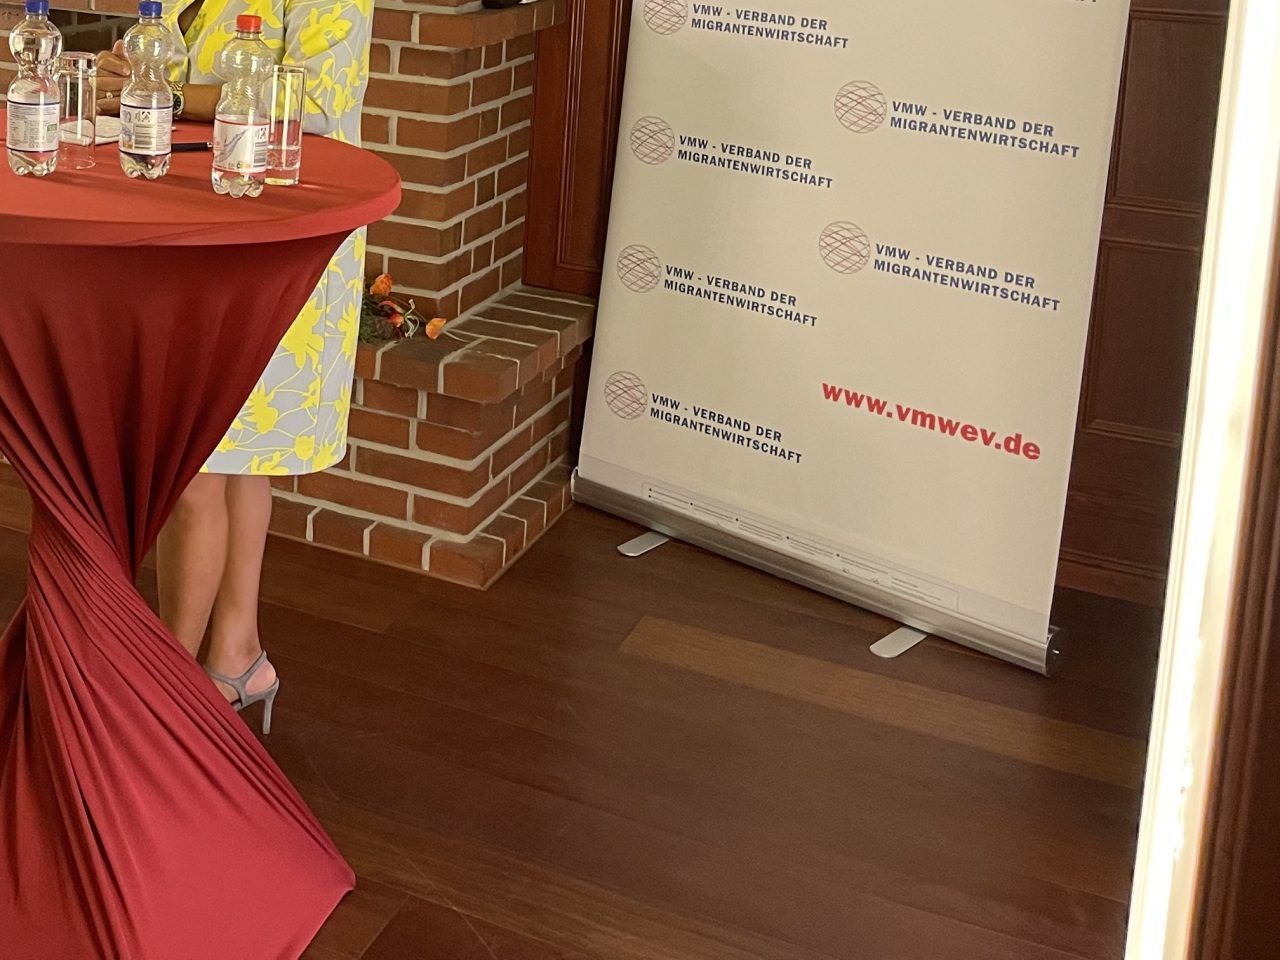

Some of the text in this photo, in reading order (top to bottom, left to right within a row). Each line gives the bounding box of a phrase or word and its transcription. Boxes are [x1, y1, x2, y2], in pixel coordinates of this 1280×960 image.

[691, 18, 849, 49] MIGRANTENWIRTSCHAFT
[693, 3, 723, 17] VMW
[735, 8, 796, 26] VERBAND
[800, 17, 828, 31] DER
[890, 116, 1080, 158] MIGRANTENWIRTSCHAFT
[892, 100, 928, 116] VMW
[943, 108, 1016, 130] VERBAND
[1022, 121, 1054, 137] DER
[677, 149, 833, 188] MIGRANTENWIRTSCHAFT
[679, 135, 709, 150] VMW
[721, 142, 780, 163] VERBAND
[785, 155, 812, 169] DER
[665, 264, 695, 281] VMW
[706, 275, 765, 298] VERBAND
[770, 291, 797, 307] DER
[873, 259, 1061, 311] MIGRANTENWIRTSCHAFT
[876, 243, 911, 261] VMW
[926, 254, 998, 280] VERBAND
[1004, 271, 1035, 289] DER
[664, 279, 817, 327] MIGRANTENWIRTSCHAFT
[650, 407, 802, 464] MIGRANTENWIRTSCHAFT
[652, 393, 680, 410] VMW
[693, 405, 751, 432] VERBAND
[756, 425, 782, 442] DER
[822, 383, 1041, 460] www.vmwev.de
